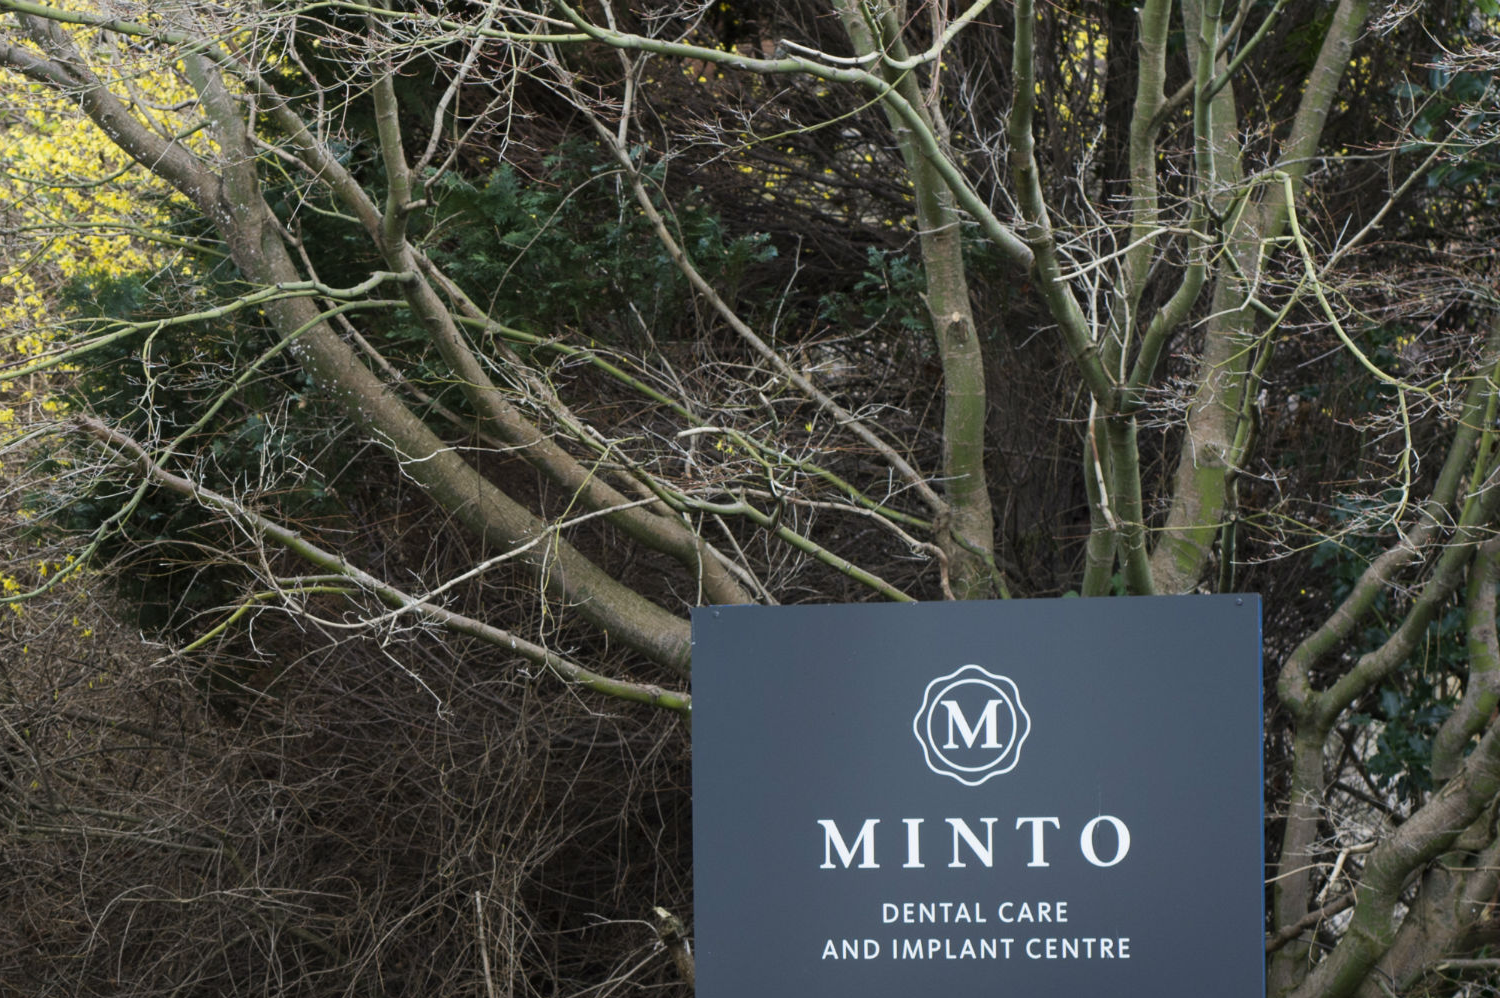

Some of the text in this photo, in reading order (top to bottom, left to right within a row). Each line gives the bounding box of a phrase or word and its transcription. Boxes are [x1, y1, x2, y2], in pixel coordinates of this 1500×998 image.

[940, 698, 1003, 750] M
[816, 813, 1131, 870] MINTO
[882, 901, 1069, 924] DENTAL CARE
[821, 937, 1131, 960] AND IMPLANT CENTRE
